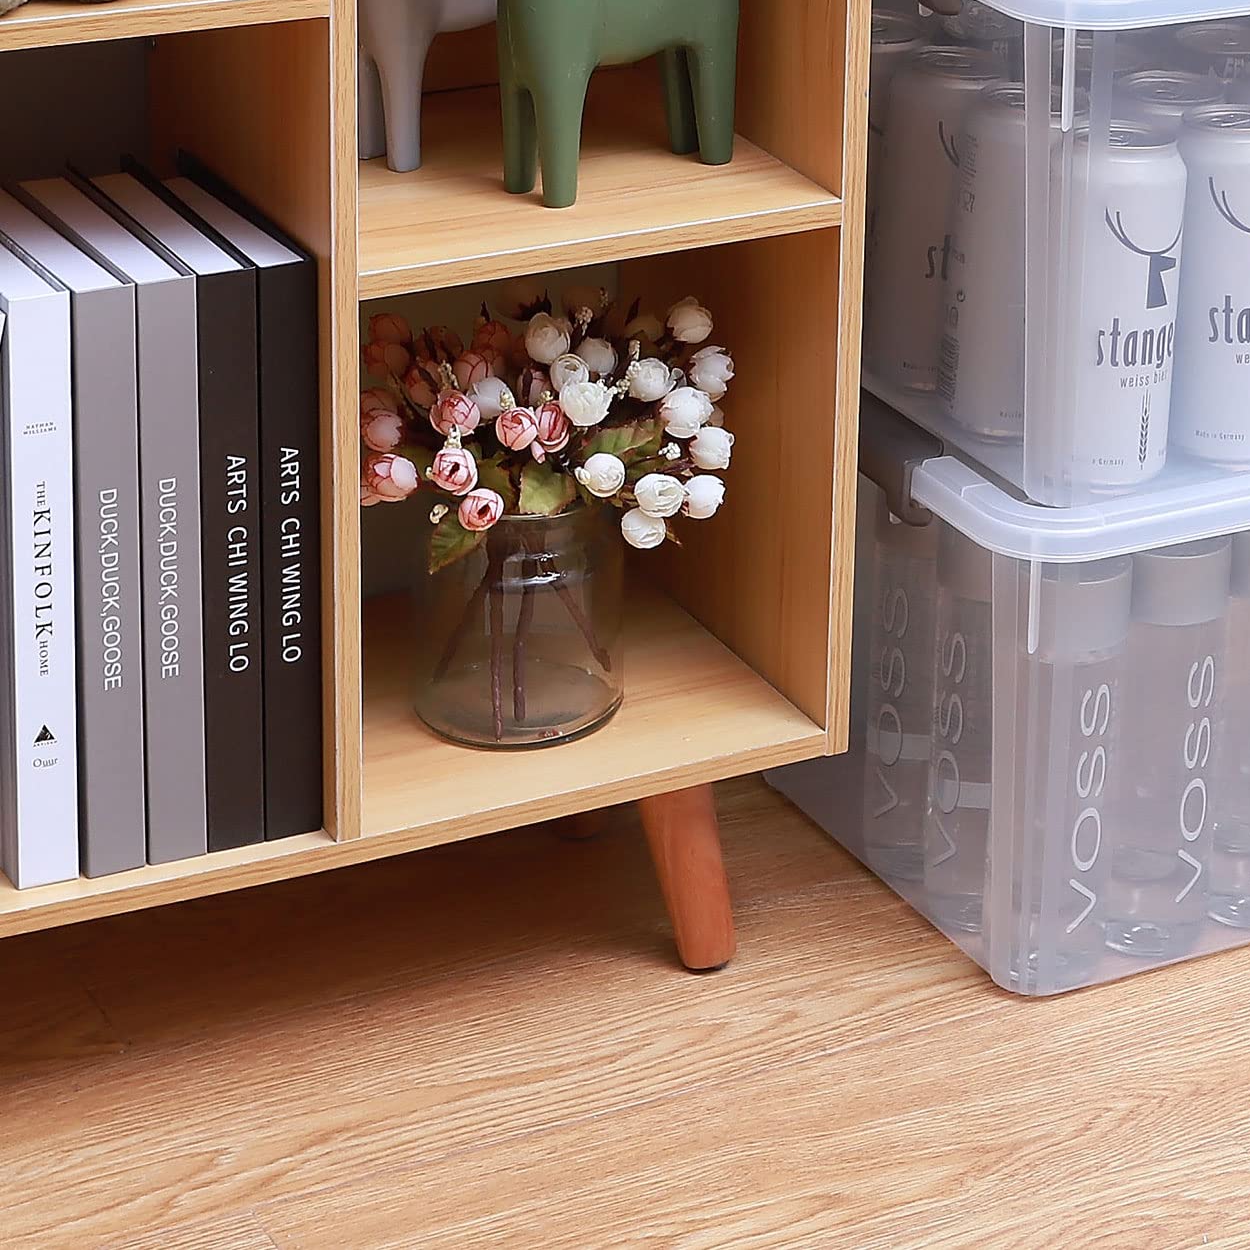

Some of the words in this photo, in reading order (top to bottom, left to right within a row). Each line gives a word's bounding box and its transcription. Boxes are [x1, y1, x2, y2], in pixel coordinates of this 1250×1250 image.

[1120, 373, 1150, 389] weiss
[36, 481, 46, 507] THE
[226, 455, 247, 514] ARTS
[280, 447, 300, 505] ARTS
[227, 526, 248, 567] CHI
[281, 518, 301, 558] CHI
[33, 507, 53, 640] KINFOLK
[98, 488, 122, 691] DUCK,DUCK,GOOSE
[157, 477, 180, 679] DUCK,DUCK,GOOSE
[228, 572, 249, 636] WING
[281, 563, 301, 626] WING
[39, 640, 49, 677] HOME
[229, 642, 249, 673] LO
[282, 633, 302, 663] LO
[874, 588, 910, 819] VOSS
[932, 631, 967, 868] VOSS
[1175, 655, 1215, 903] VOSS
[1066, 684, 1111, 934] VOSS
